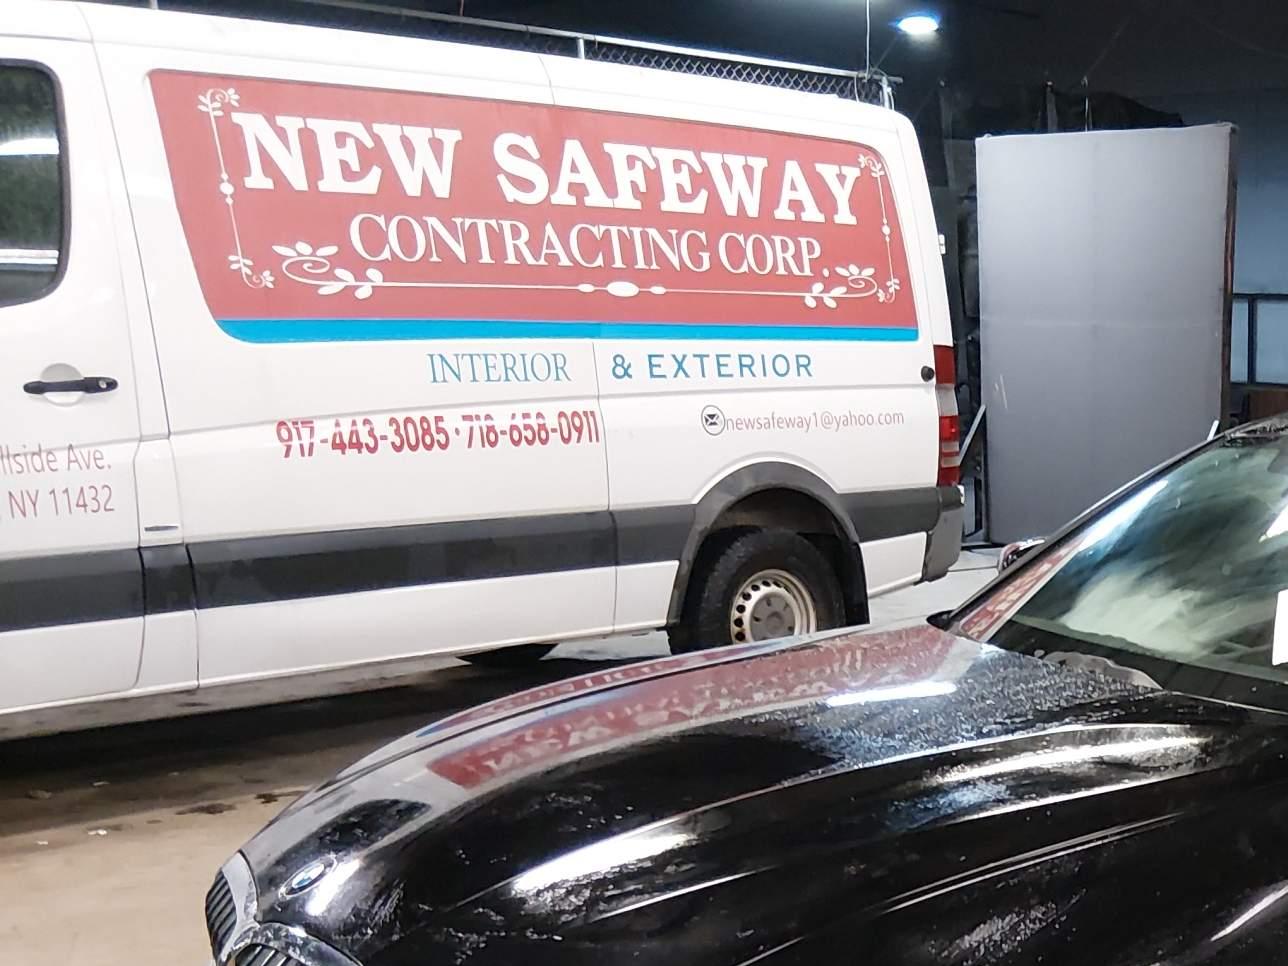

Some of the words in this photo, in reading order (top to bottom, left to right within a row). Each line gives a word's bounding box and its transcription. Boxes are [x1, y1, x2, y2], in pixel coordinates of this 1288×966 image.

[230, 112, 463, 199] NEW
[493, 131, 862, 226] SAFEWAY
[349, 213, 711, 273] CONTRACTING
[718, 231, 830, 279] CORP.
[427, 352, 571, 384] INTERIOR
[611, 354, 632, 379] &
[647, 352, 813, 378] EXTERIOR
[276, 415, 450, 459] 917-443-3085
[461, 410, 600, 449] 718-658-0911
[725, 410, 905, 433] newsafeway1@yahoo.com
[67, 443, 112, 472] Ave.
[8, 488, 39, 519] NY
[49, 484, 116, 517] 11432
